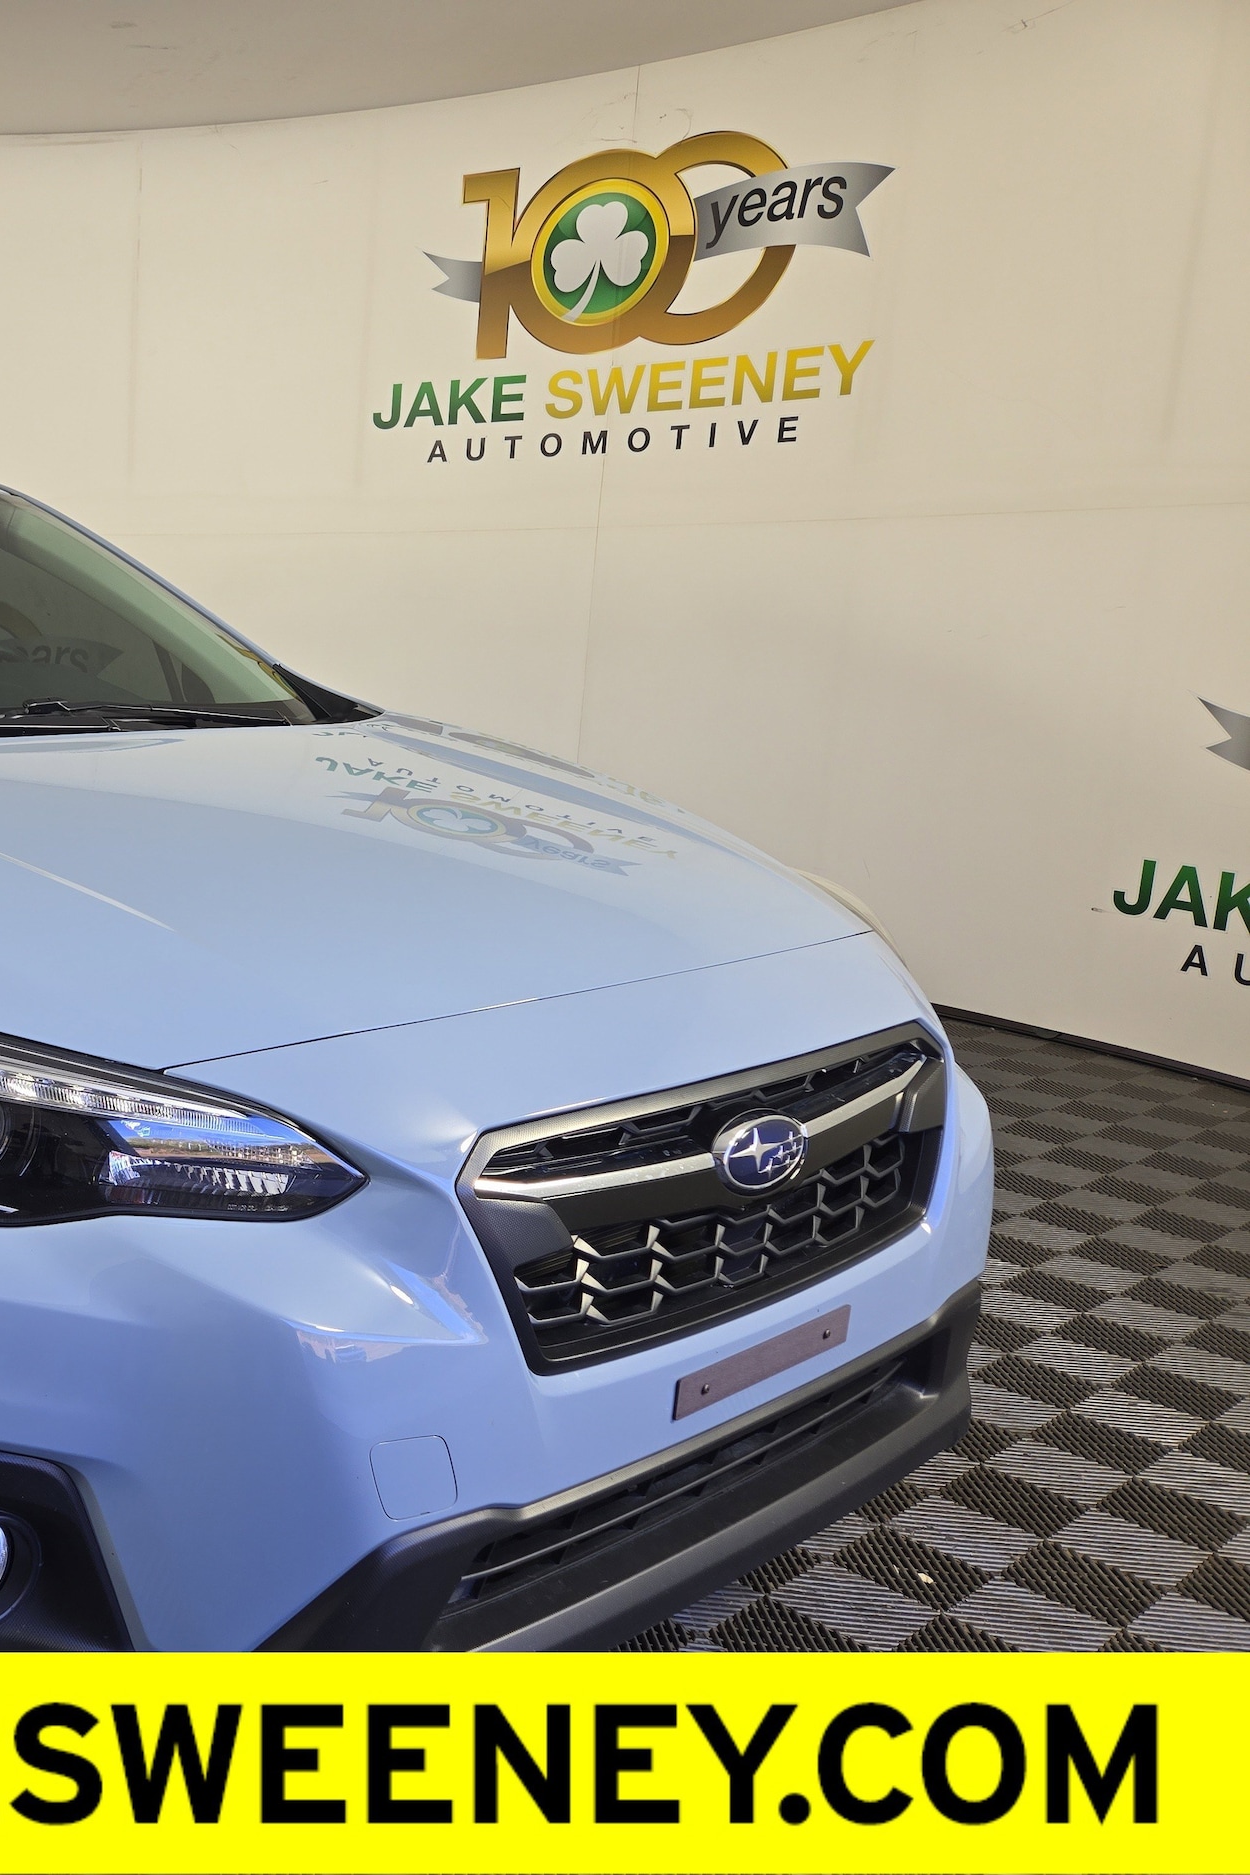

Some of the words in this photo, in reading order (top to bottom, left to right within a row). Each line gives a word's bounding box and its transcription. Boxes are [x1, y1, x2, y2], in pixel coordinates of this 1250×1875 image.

[705, 174, 848, 250] years
[372, 374, 527, 430] JAKE
[544, 339, 876, 420] SWEENEY
[427, 415, 800, 463] AUTOMOTIVE
